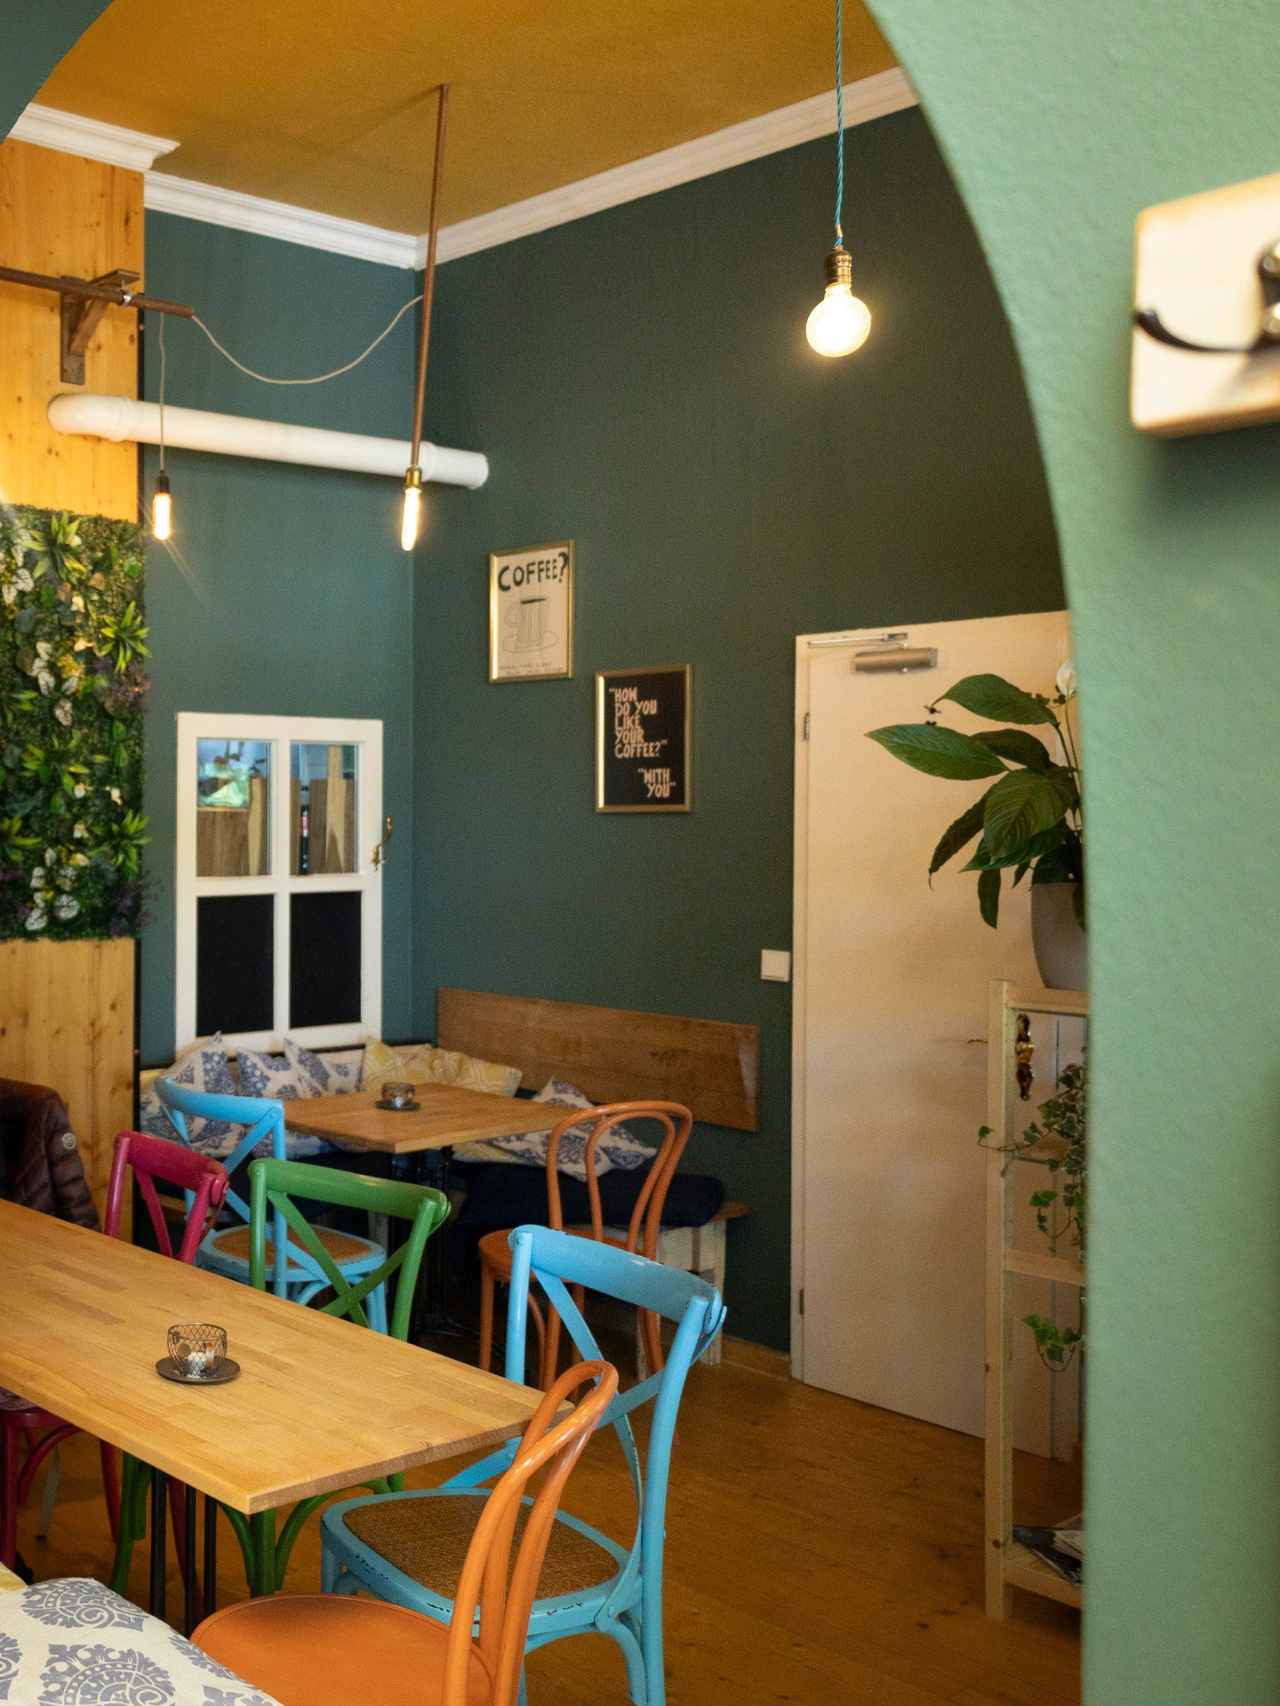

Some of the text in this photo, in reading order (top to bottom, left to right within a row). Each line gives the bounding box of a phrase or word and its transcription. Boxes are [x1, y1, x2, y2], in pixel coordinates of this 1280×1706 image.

[498, 552, 569, 592] COFFEE?
[615, 699, 658, 717] DO YOU
[615, 715, 642, 731] LIKE
[614, 729, 645, 745] YOUR
